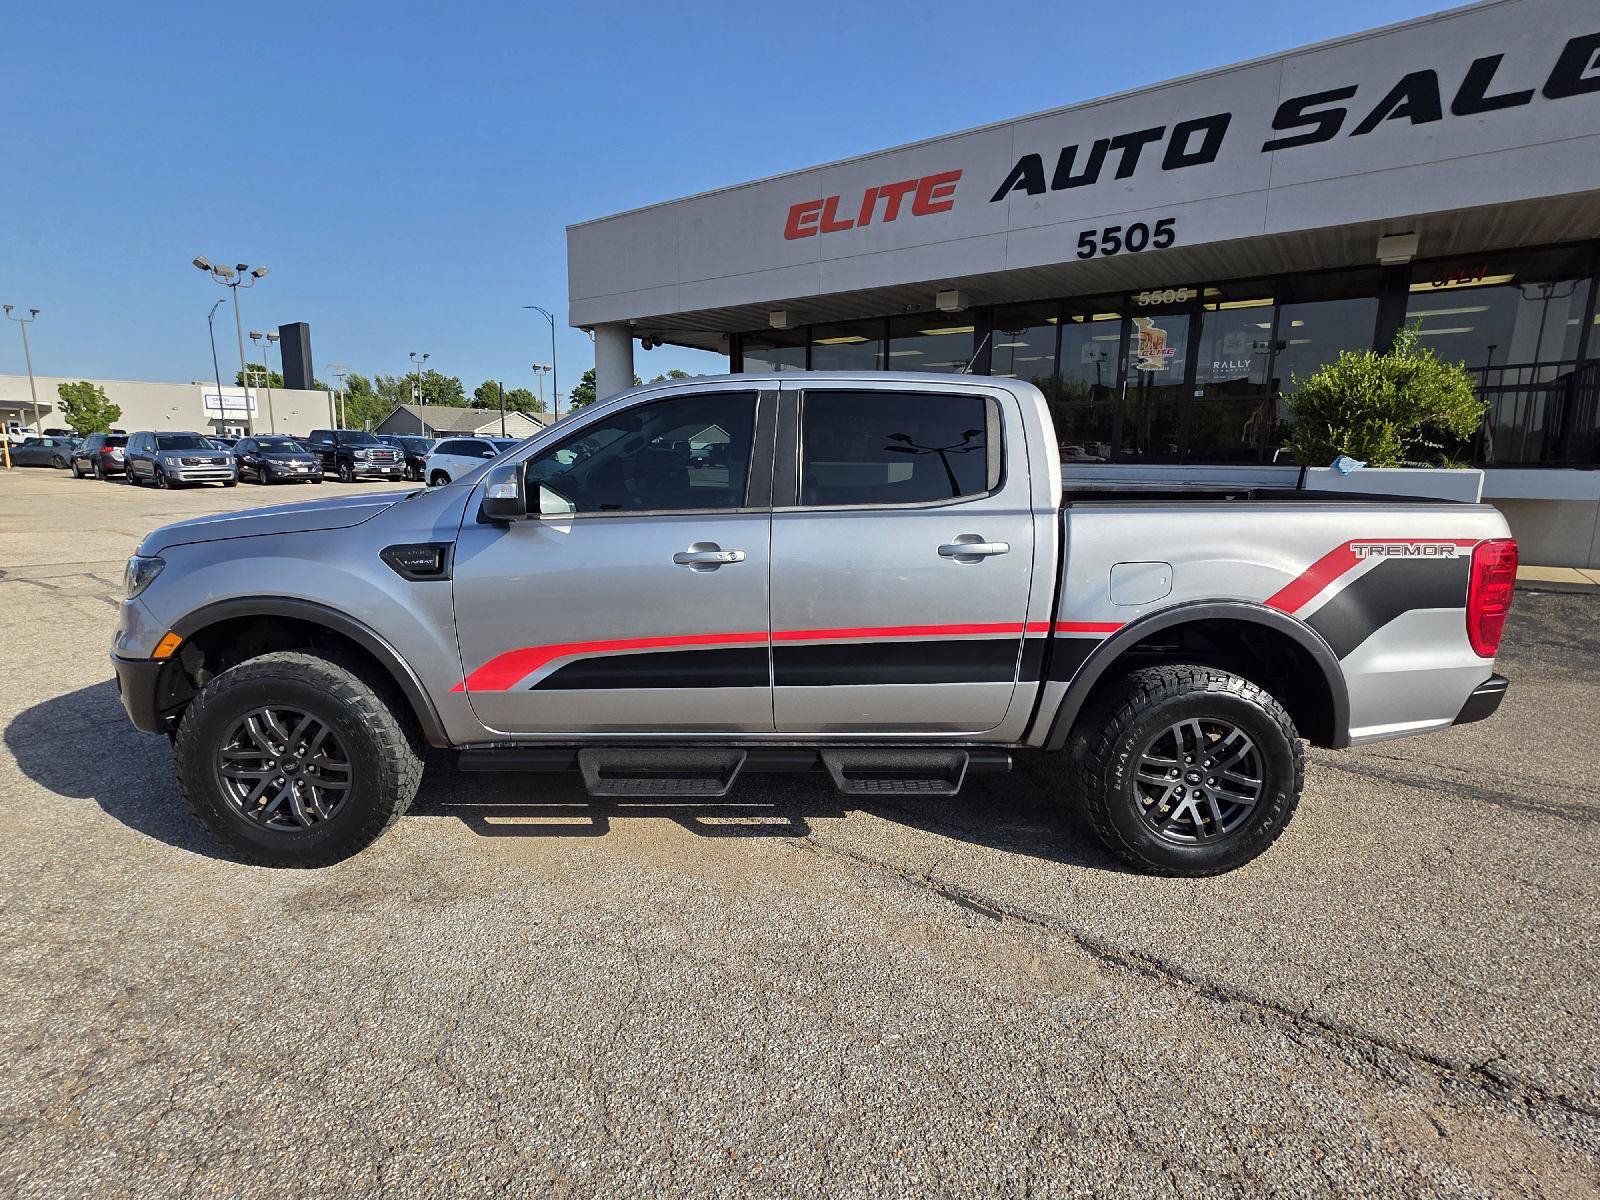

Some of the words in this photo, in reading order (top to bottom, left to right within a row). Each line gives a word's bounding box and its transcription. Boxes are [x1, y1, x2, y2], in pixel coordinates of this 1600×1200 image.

[784, 169, 962, 240] ELITE
[989, 112, 1232, 202] AUTO
[1077, 217, 1176, 259] 5505
[1138, 287, 1188, 306] 5505
[1141, 347, 1177, 358] ELITE
[1213, 359, 1251, 369] RALLY
[1351, 543, 1459, 558] TREMOR
